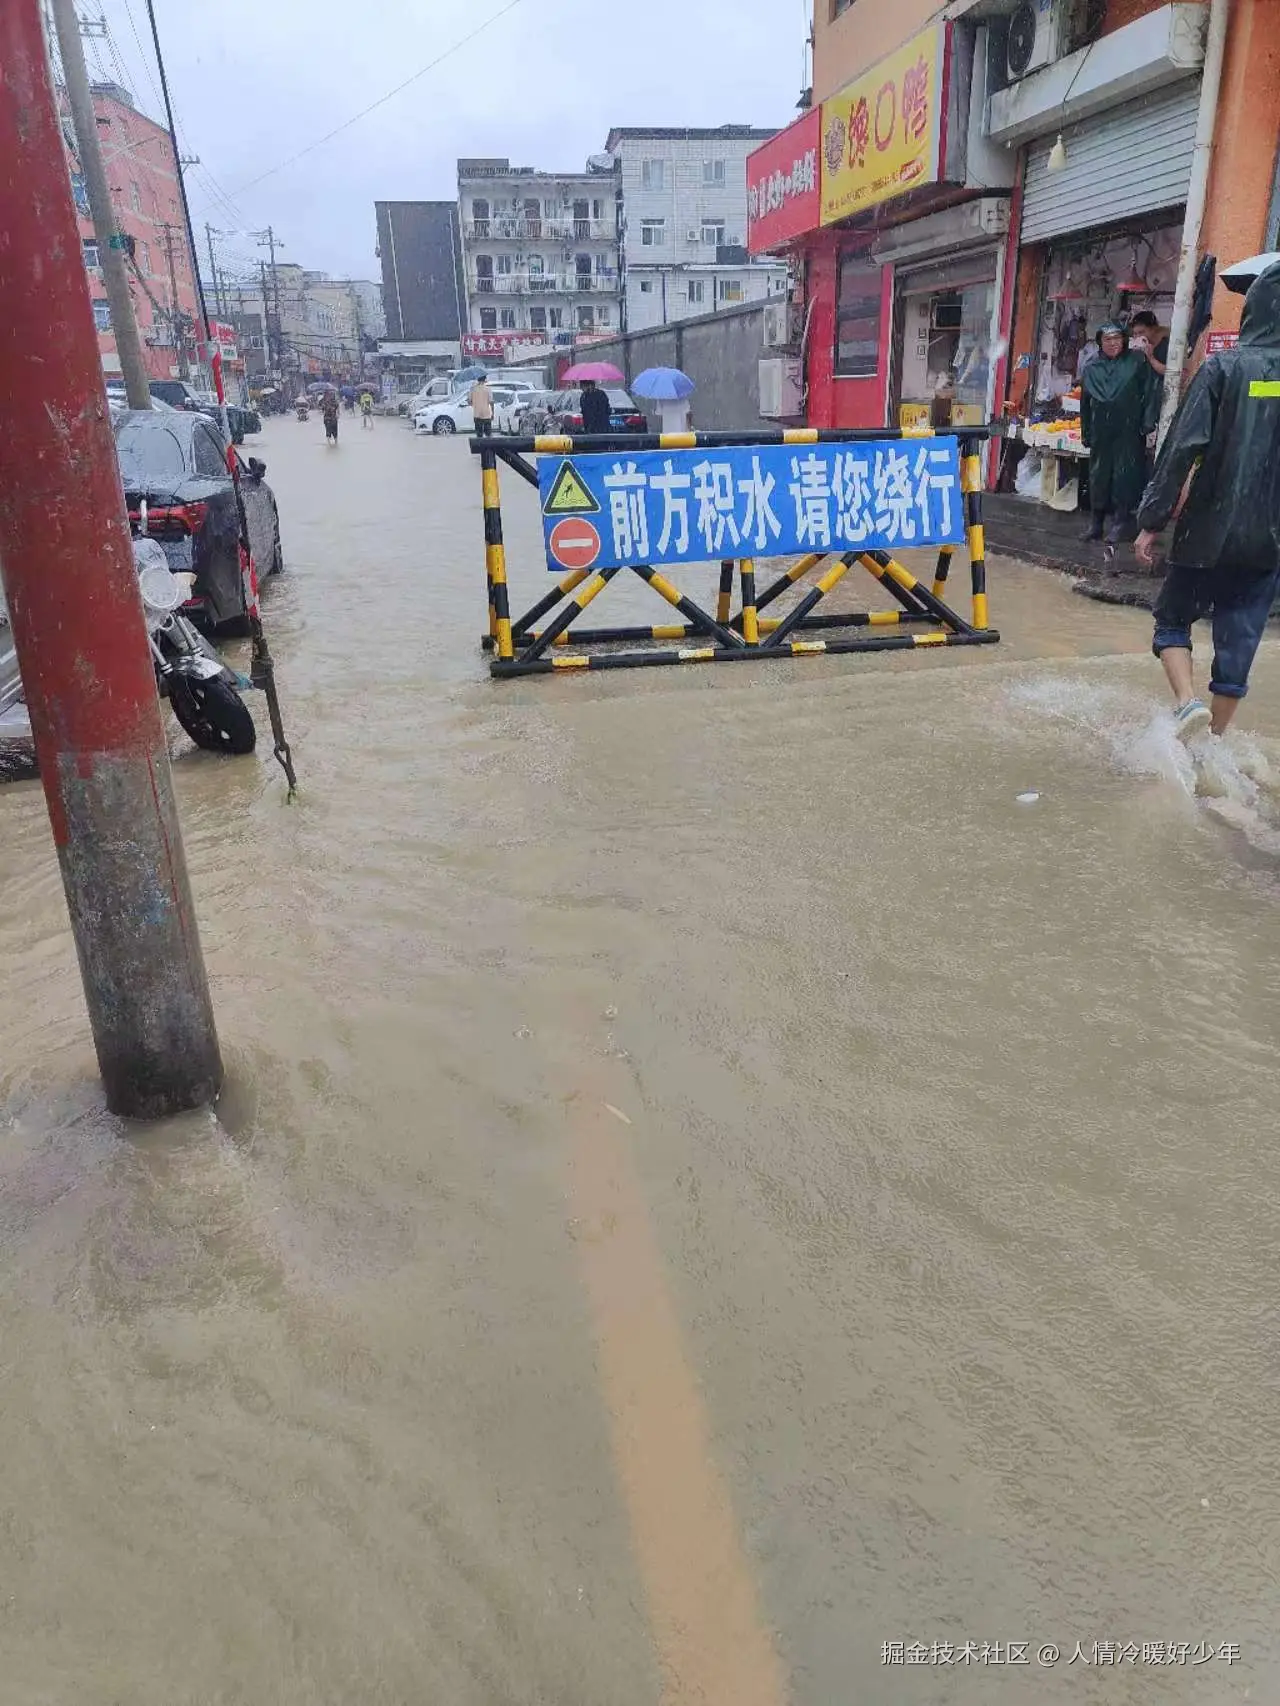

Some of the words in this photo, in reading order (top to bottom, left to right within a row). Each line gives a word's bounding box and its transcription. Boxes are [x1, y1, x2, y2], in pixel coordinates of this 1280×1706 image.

[603, 456, 782, 560] 前方积水
[789, 447, 955, 548] 请您绕行
